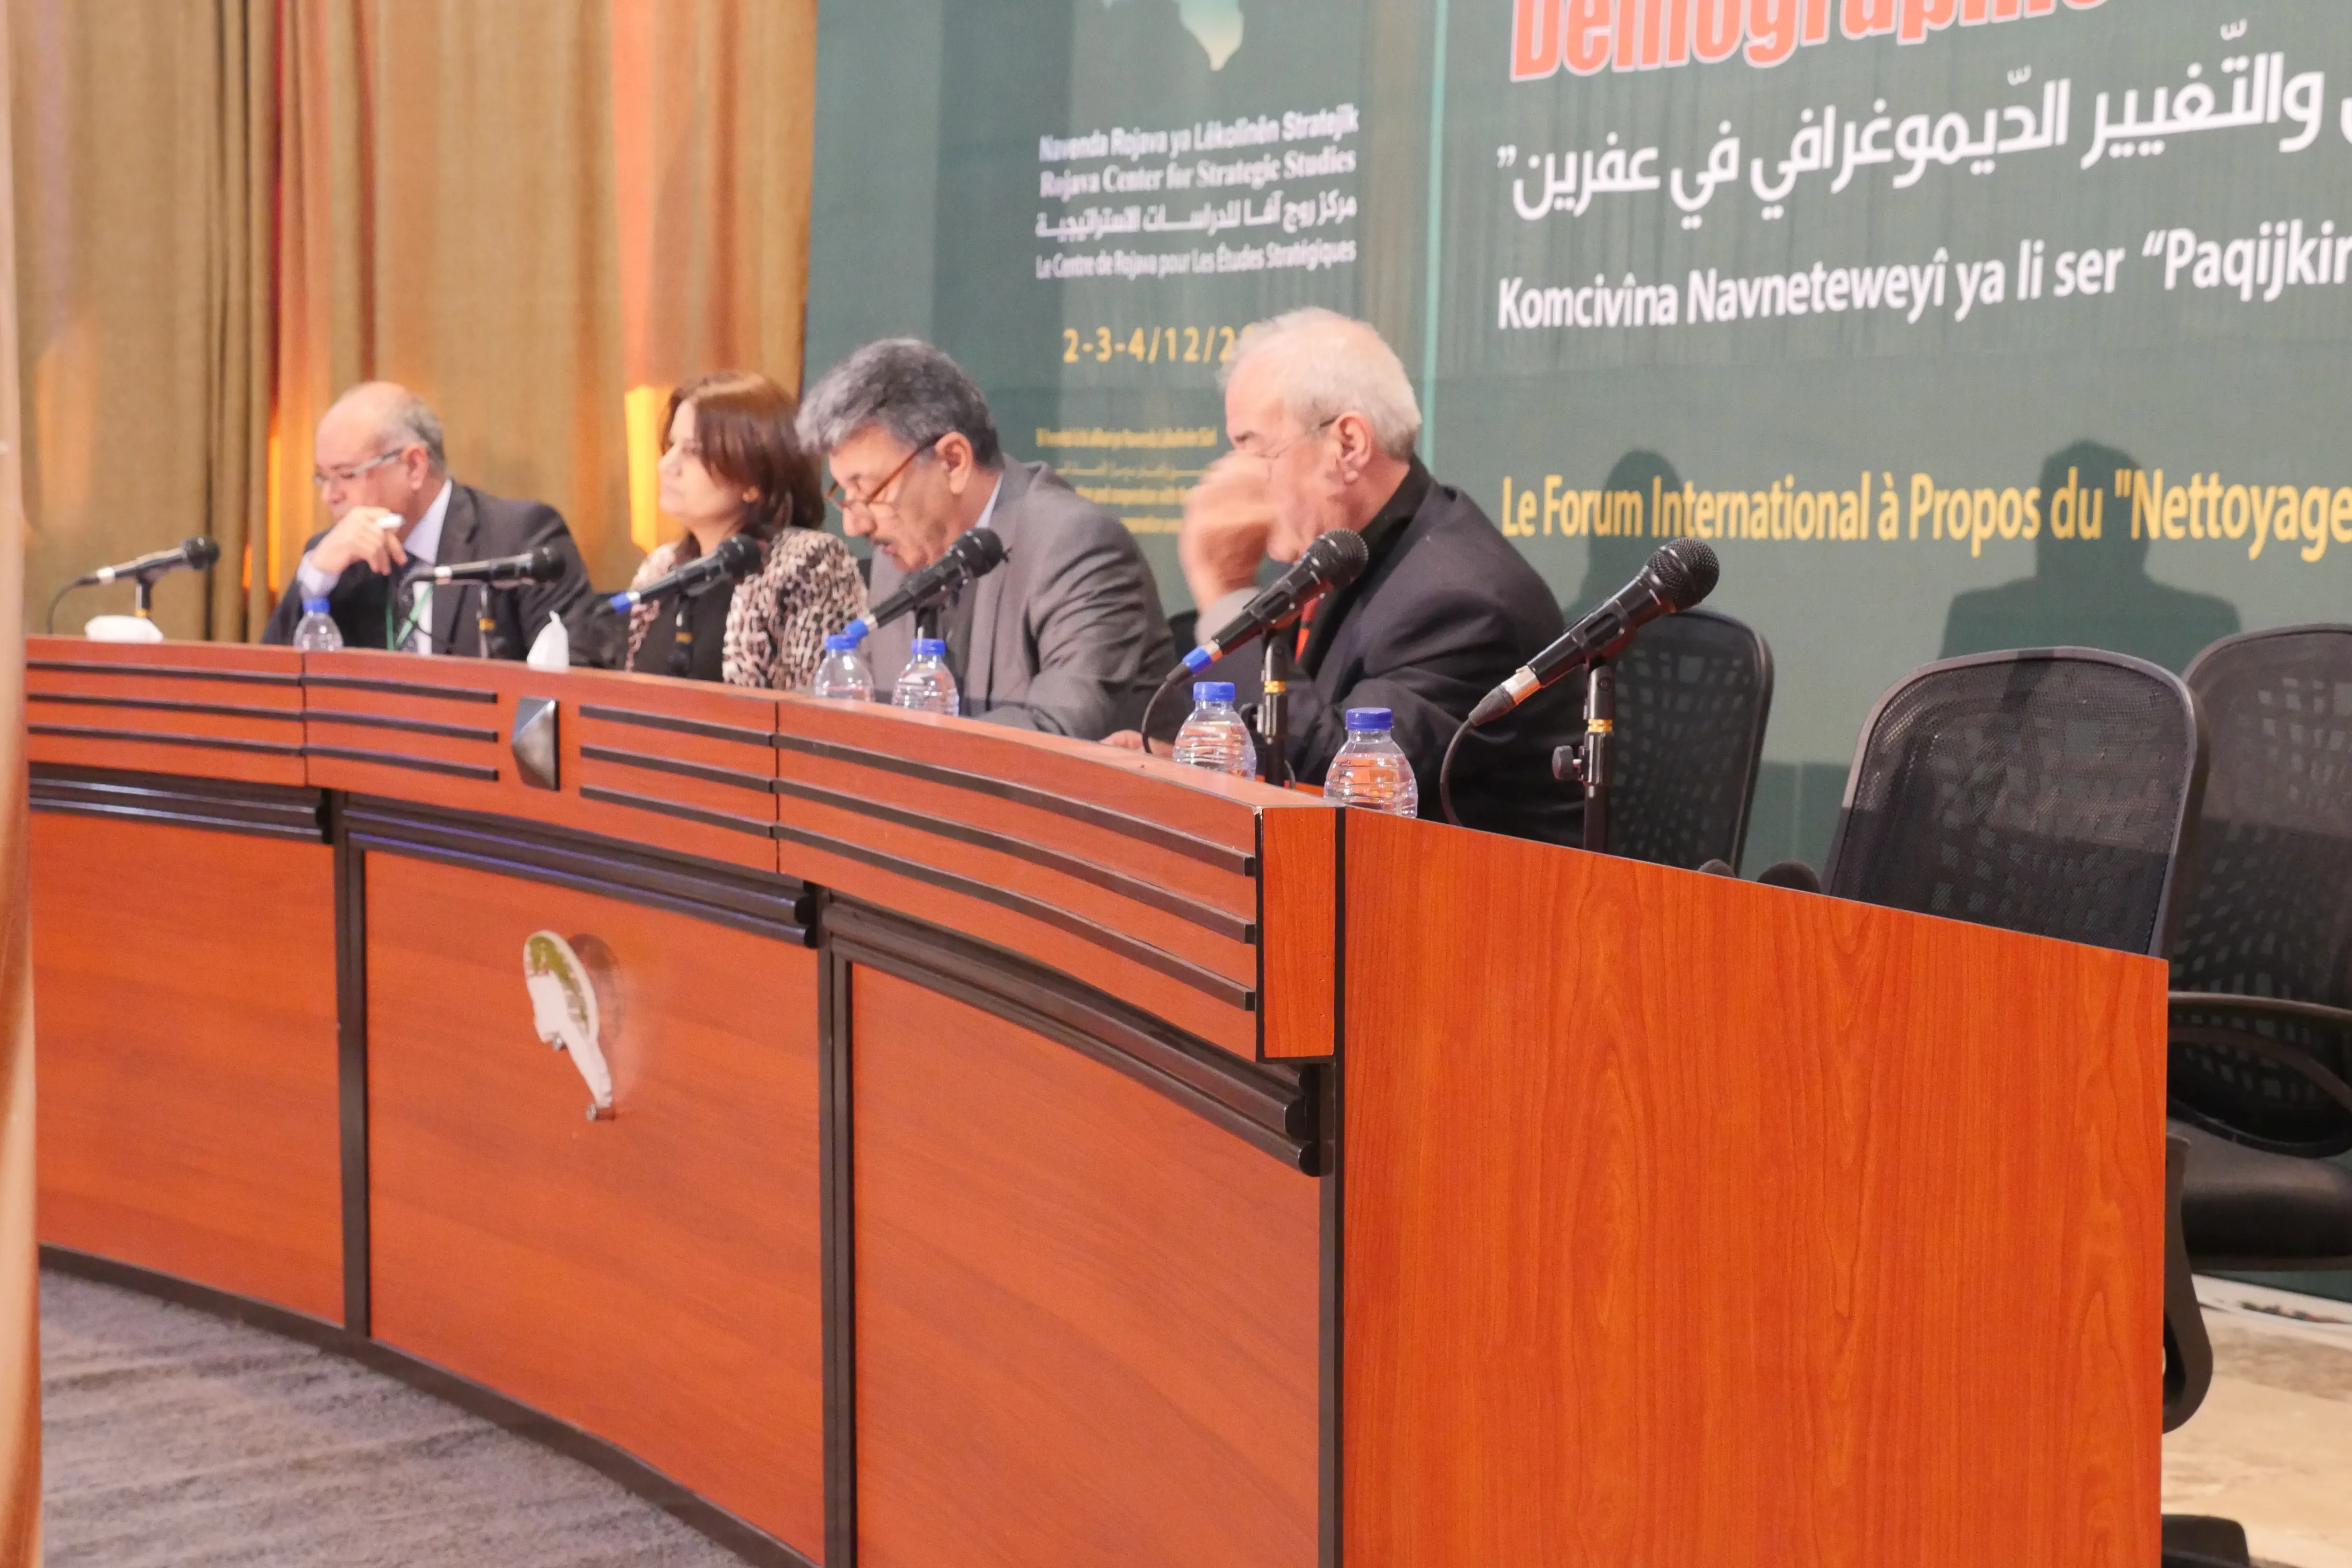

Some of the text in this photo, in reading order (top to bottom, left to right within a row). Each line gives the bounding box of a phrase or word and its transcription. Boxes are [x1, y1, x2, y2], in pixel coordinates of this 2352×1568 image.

[1111, 127, 1168, 162] Rojava
[1170, 129, 1192, 159] ya
[1040, 145, 1357, 203] Rojava Center for Strategic Studies
[1670, 119, 1741, 230] في
[1316, 188, 1358, 226] مركز
[1498, 272, 1679, 330] Komcivîna
[1686, 246, 1949, 325] Navneteweyî
[1954, 259, 2006, 323] ya
[2017, 239, 2045, 301] li
[2053, 248, 2126, 297] ser
[1063, 325, 1254, 363] 2-3-4/12/2
[1502, 476, 1537, 537] Le
[1543, 474, 1643, 537] Forum
[1651, 470, 1871, 541] International
[1877, 471, 1900, 541] à
[1909, 472, 2041, 558] Propos
[2050, 466, 2103, 540] du
